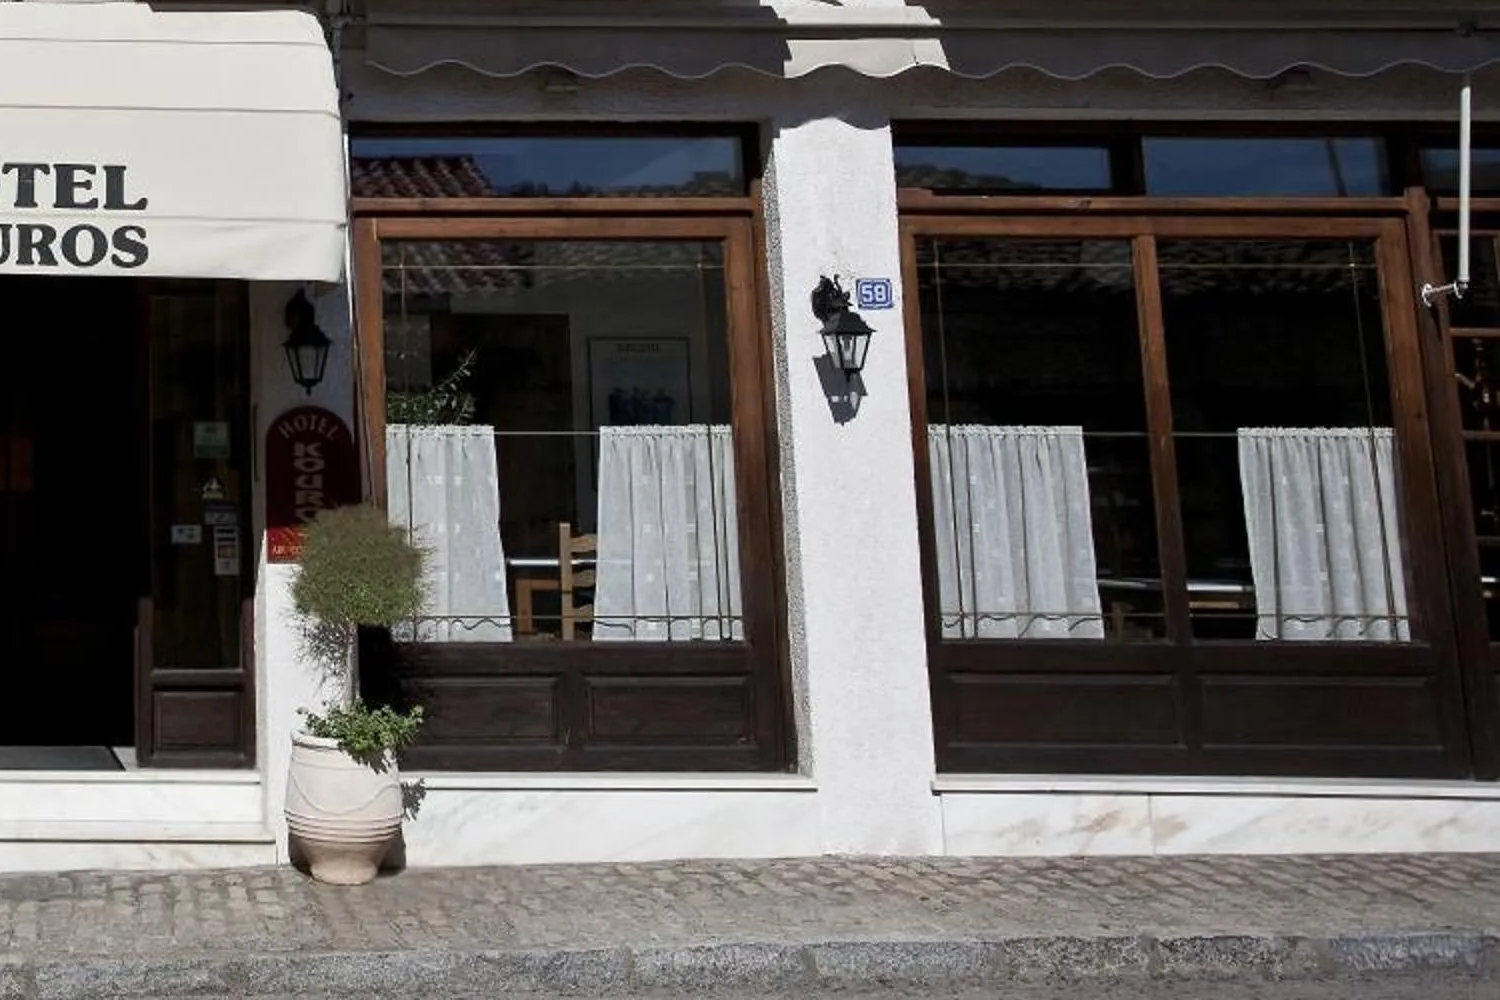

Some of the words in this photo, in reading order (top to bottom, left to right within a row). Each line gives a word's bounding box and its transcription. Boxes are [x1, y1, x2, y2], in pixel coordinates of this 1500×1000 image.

[860, 285, 887, 303] 58
[277, 412, 340, 441] HOTEL
[292, 442, 325, 524] KOURO
